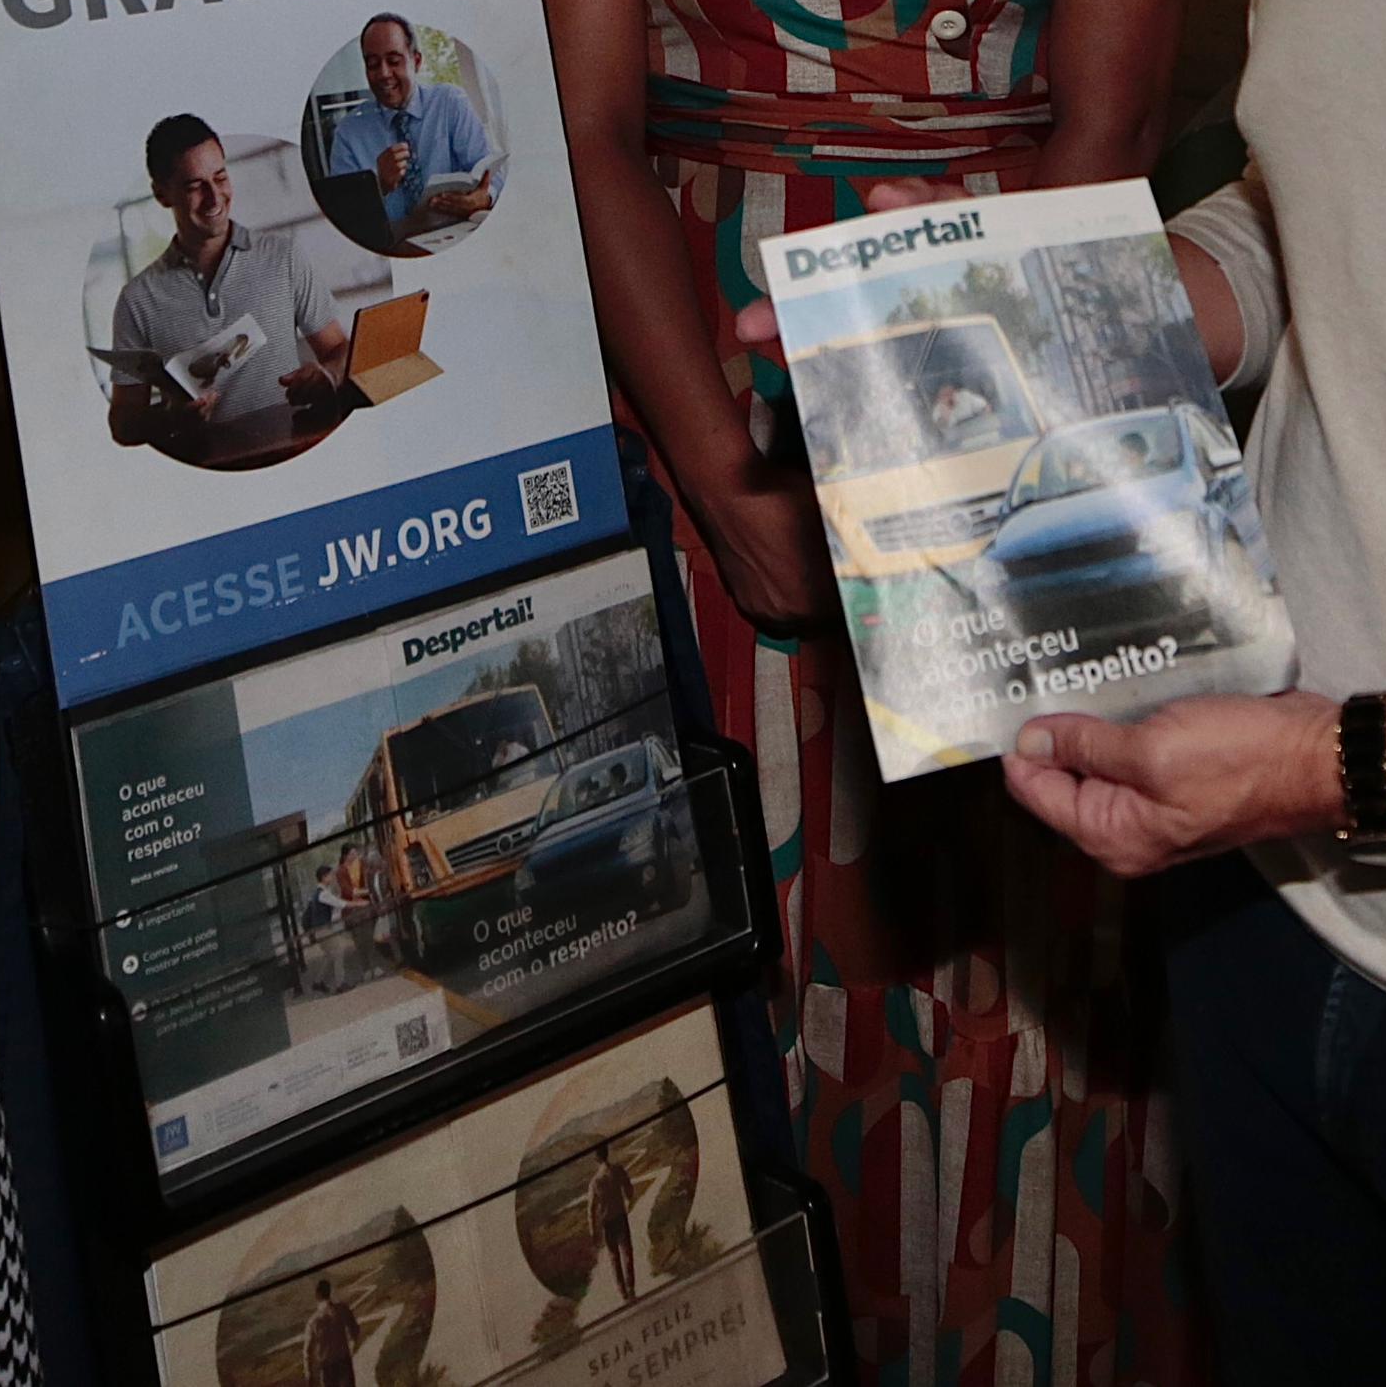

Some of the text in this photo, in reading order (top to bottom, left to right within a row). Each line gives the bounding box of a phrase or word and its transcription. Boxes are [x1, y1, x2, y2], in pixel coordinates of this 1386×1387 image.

[784, 211, 985, 281] Despertai!
[116, 498, 493, 649] ACESSE JW.ORG
[402, 595, 535, 666] Despertai!
[914, 607, 1005, 647] O que
[922, 626, 1079, 686] aconteceu
[1007, 680, 1026, 704] o
[1035, 635, 1178, 697] respeito?
[119, 775, 167, 801] O que
[122, 782, 205, 822] aconteceu
[124, 815, 174, 842] com o
[127, 822, 202, 862] respeito?
[146, 902, 196, 928] importante
[473, 905, 533, 943] O que
[478, 915, 577, 971] aconteceu
[483, 910, 638, 997] com o respeito?
[588, 1338, 634, 1378] SEJA
[642, 1301, 693, 1344] FELIZ
[628, 1303, 747, 1387] SEMPRE!
